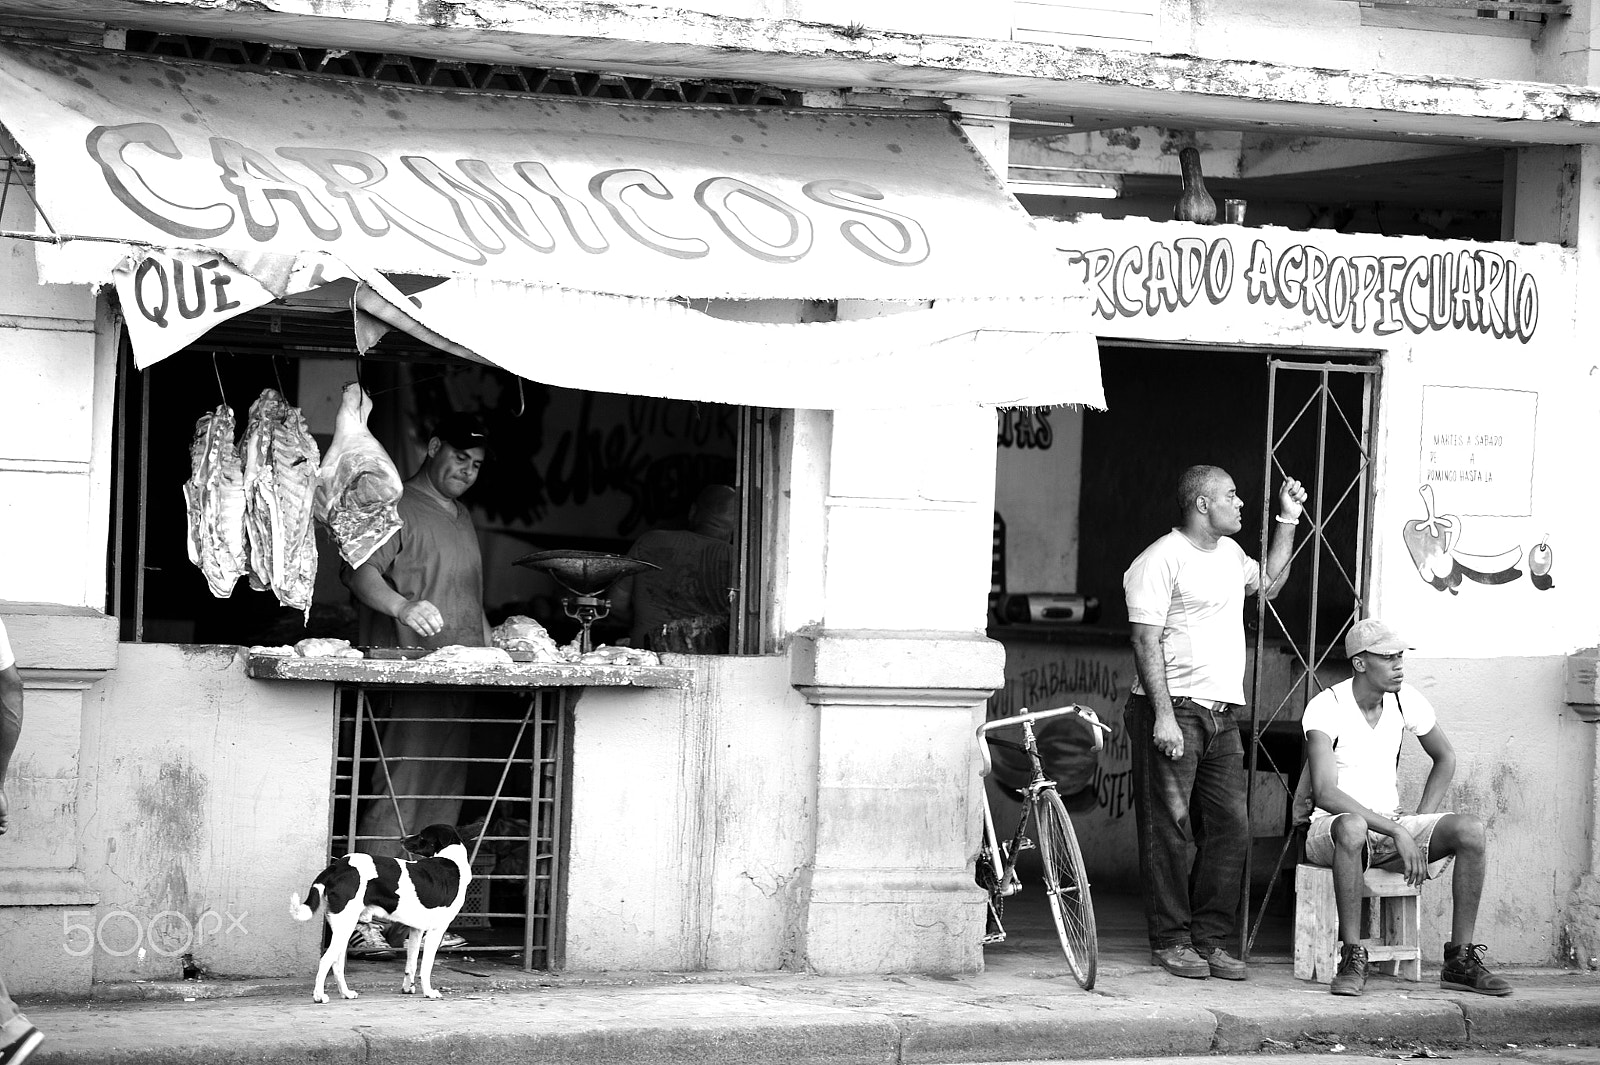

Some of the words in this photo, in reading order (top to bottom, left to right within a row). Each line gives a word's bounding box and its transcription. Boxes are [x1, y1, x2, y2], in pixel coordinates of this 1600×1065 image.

[87, 122, 930, 266] CARNICOS
[1056, 238, 1234, 320] RCADO
[1244, 239, 1538, 344] AGROPECUARIO
[997, 406, 1053, 449] TAS
[1474, 434, 1502, 447] SABADO
[1427, 469, 1457, 482] DOMINGO
[1460, 469, 1482, 482] HASTA
[1485, 472, 1492, 483] LA
[988, 677, 1014, 719] QUI
[1020, 658, 1118, 707] TRABAJAMOS
